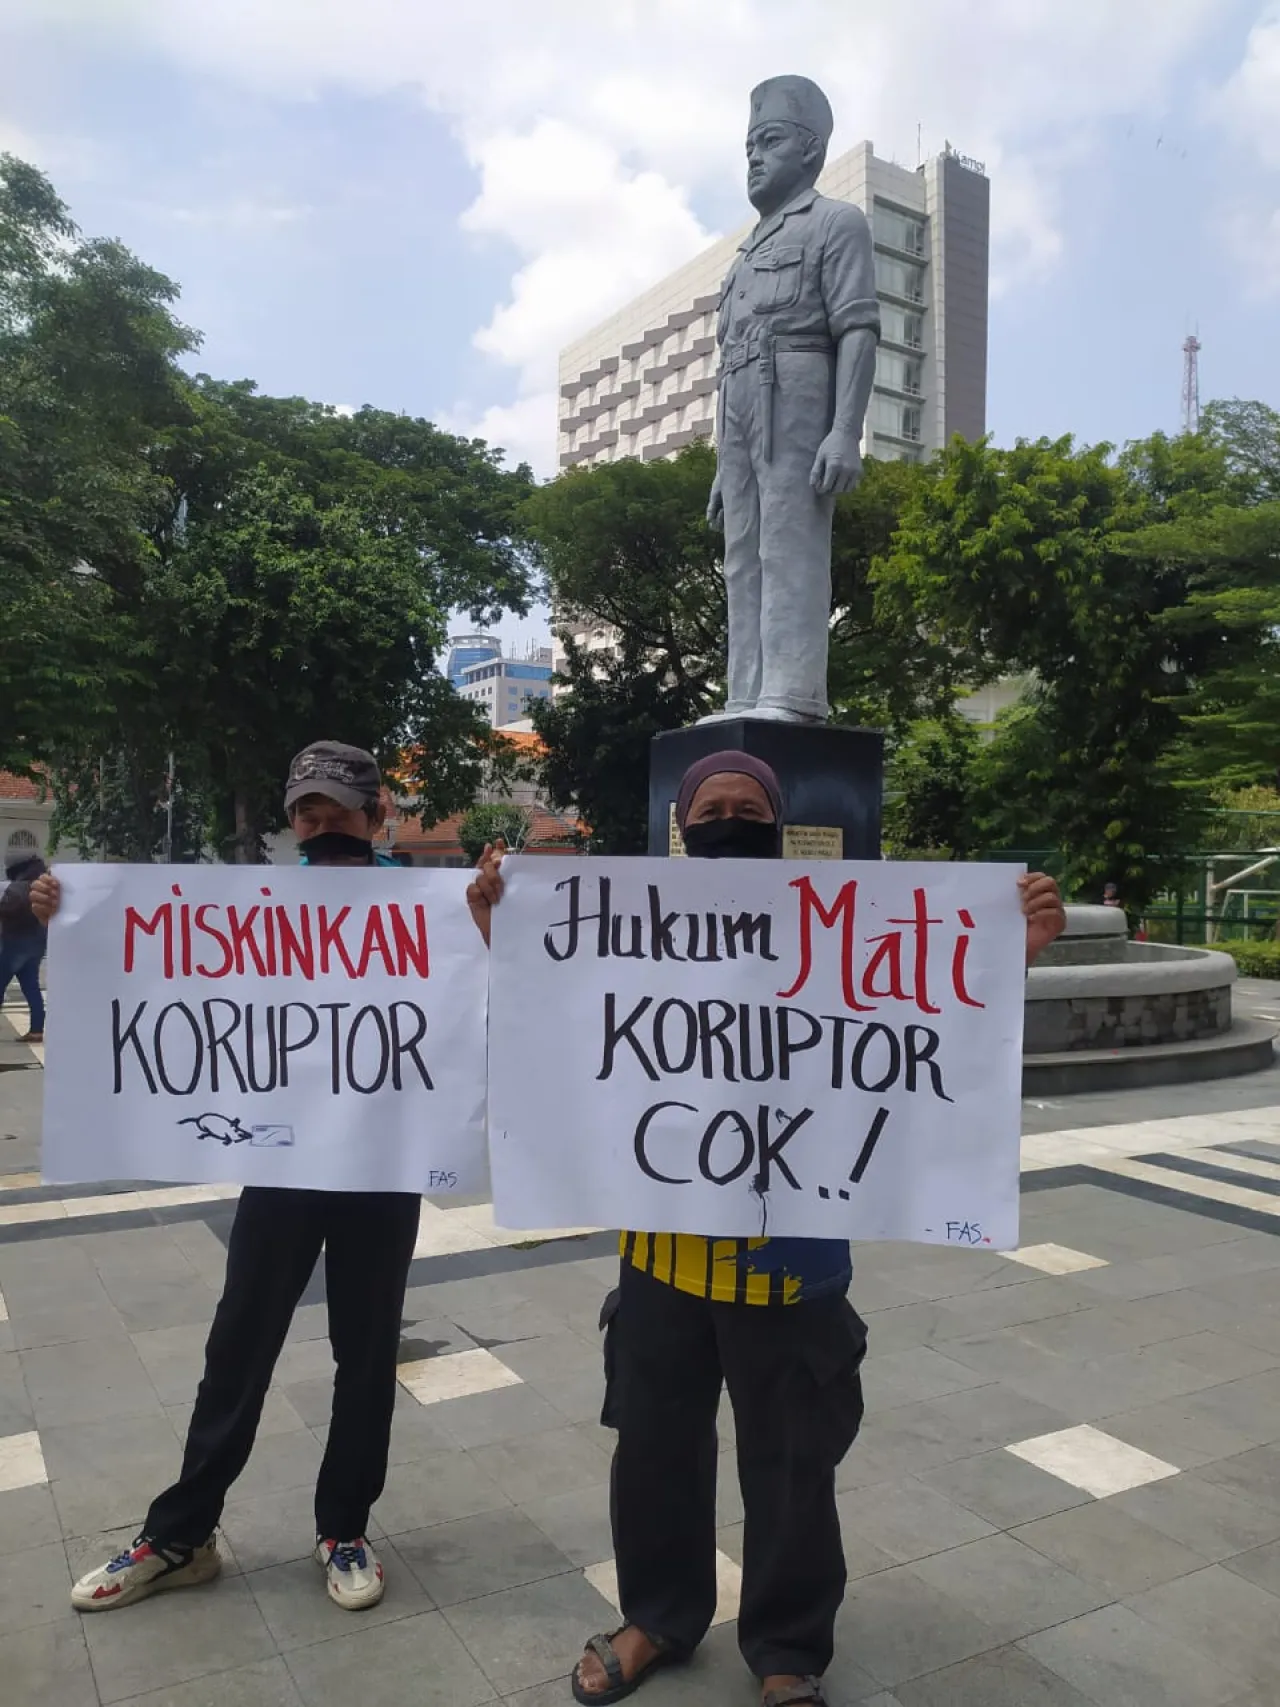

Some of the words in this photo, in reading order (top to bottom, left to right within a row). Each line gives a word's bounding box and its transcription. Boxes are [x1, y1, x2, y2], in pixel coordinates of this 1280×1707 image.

[544, 876, 779, 962] Hukum
[777, 876, 986, 1013] Mati
[112, 999, 434, 1095] KORUPTOR
[596, 992, 955, 1103] KORUPTOR
[429, 1170, 459, 1189] FAS
